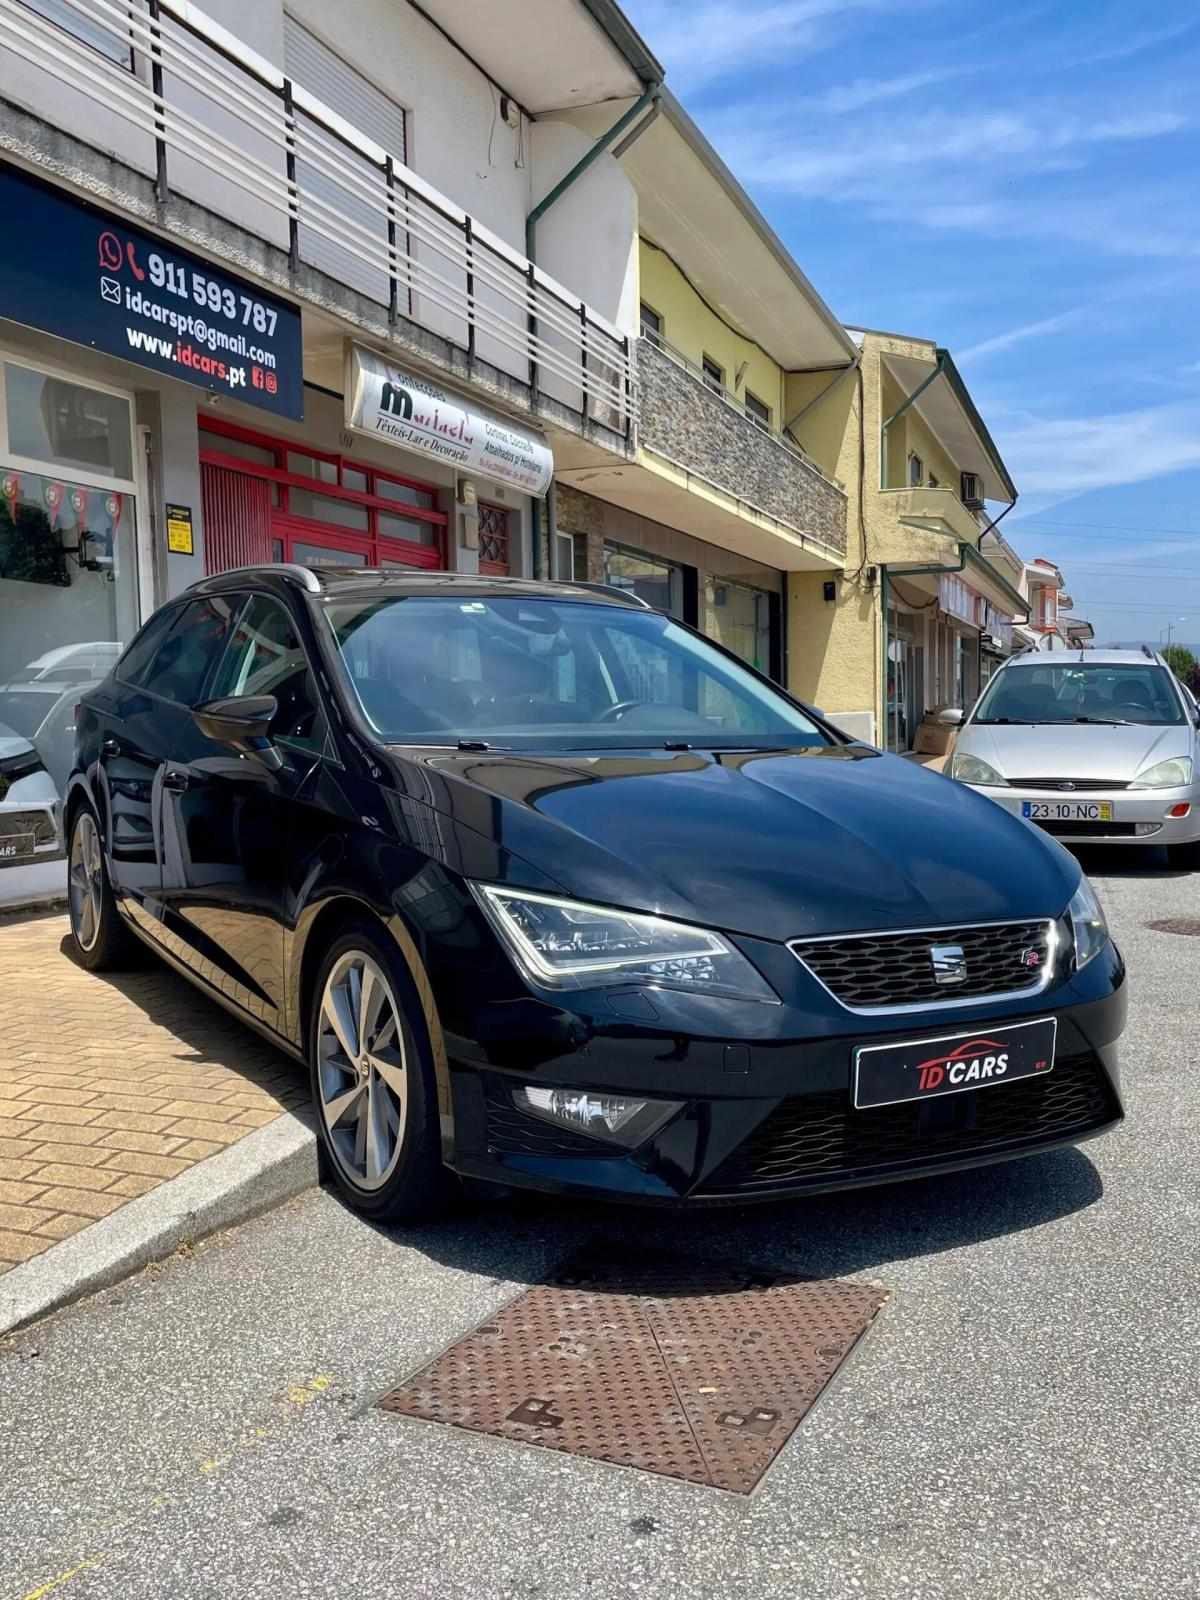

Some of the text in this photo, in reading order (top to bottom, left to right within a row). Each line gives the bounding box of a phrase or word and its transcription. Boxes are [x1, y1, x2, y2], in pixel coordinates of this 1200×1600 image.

[125, 287, 276, 368] idcarspt@gmail.com
[148, 253, 278, 337] 911 593 787
[126, 327, 247, 389] www.idcars.pt
